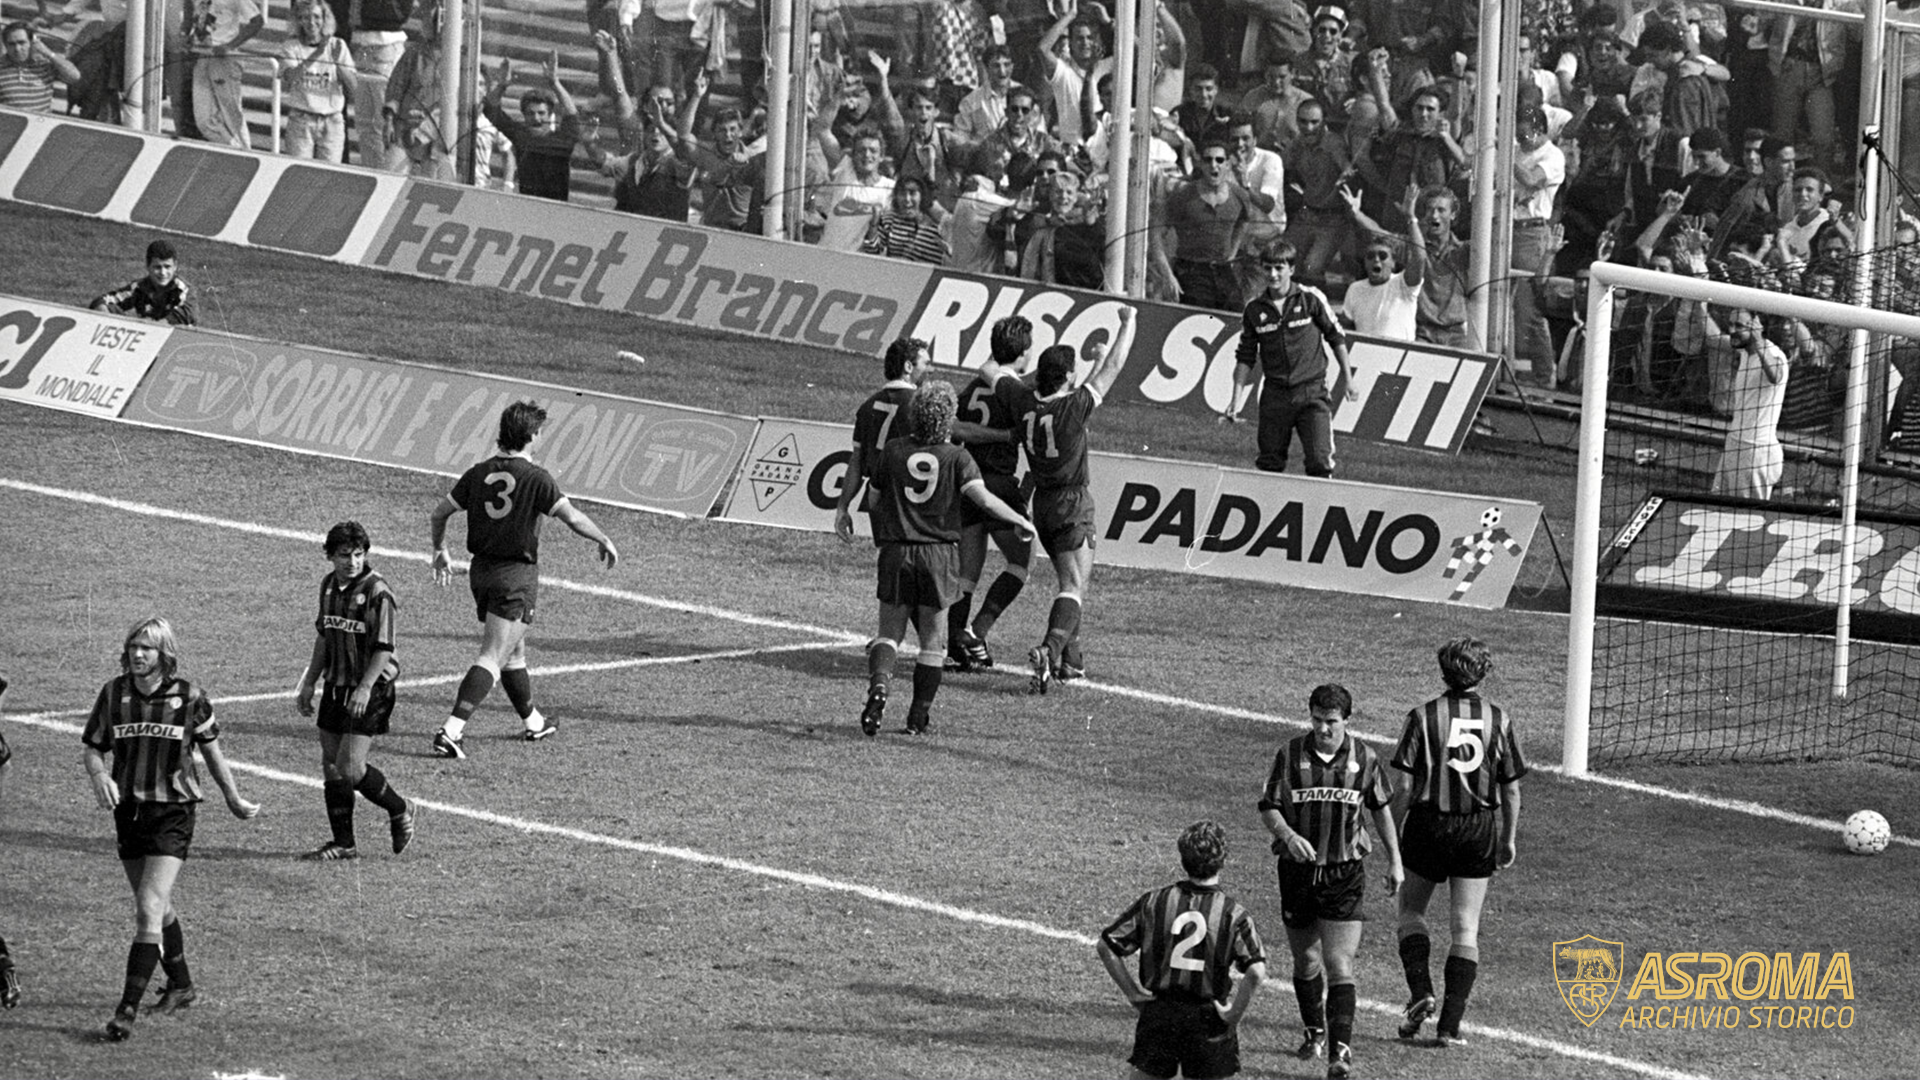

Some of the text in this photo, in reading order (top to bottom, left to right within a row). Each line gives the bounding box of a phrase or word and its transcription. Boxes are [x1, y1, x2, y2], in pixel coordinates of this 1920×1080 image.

[374, 181, 898, 353] Fernet Branca
[89, 324, 146, 352] VESTE
[911, 277, 1137, 390] RISO
[87, 354, 105, 376] IL
[35, 374, 125, 409] MONDIALE
[161, 366, 241, 415] TV
[967, 387, 996, 427] 5
[232, 354, 646, 490] SORRISI E CAZONI
[872, 401, 900, 450] 7
[1022, 411, 1059, 458] 11
[638, 443, 721, 492] TV
[751, 470, 800, 482] PADANO
[778, 447, 789, 458] G
[484, 471, 517, 520] 3
[764, 486, 775, 498] P
[904, 452, 940, 503] 9
[1104, 481, 1441, 574] PADANO
[1446, 717, 1485, 774] 5
[1296, 788, 1361, 803] TAMOIL
[1169, 910, 1208, 972] 2
